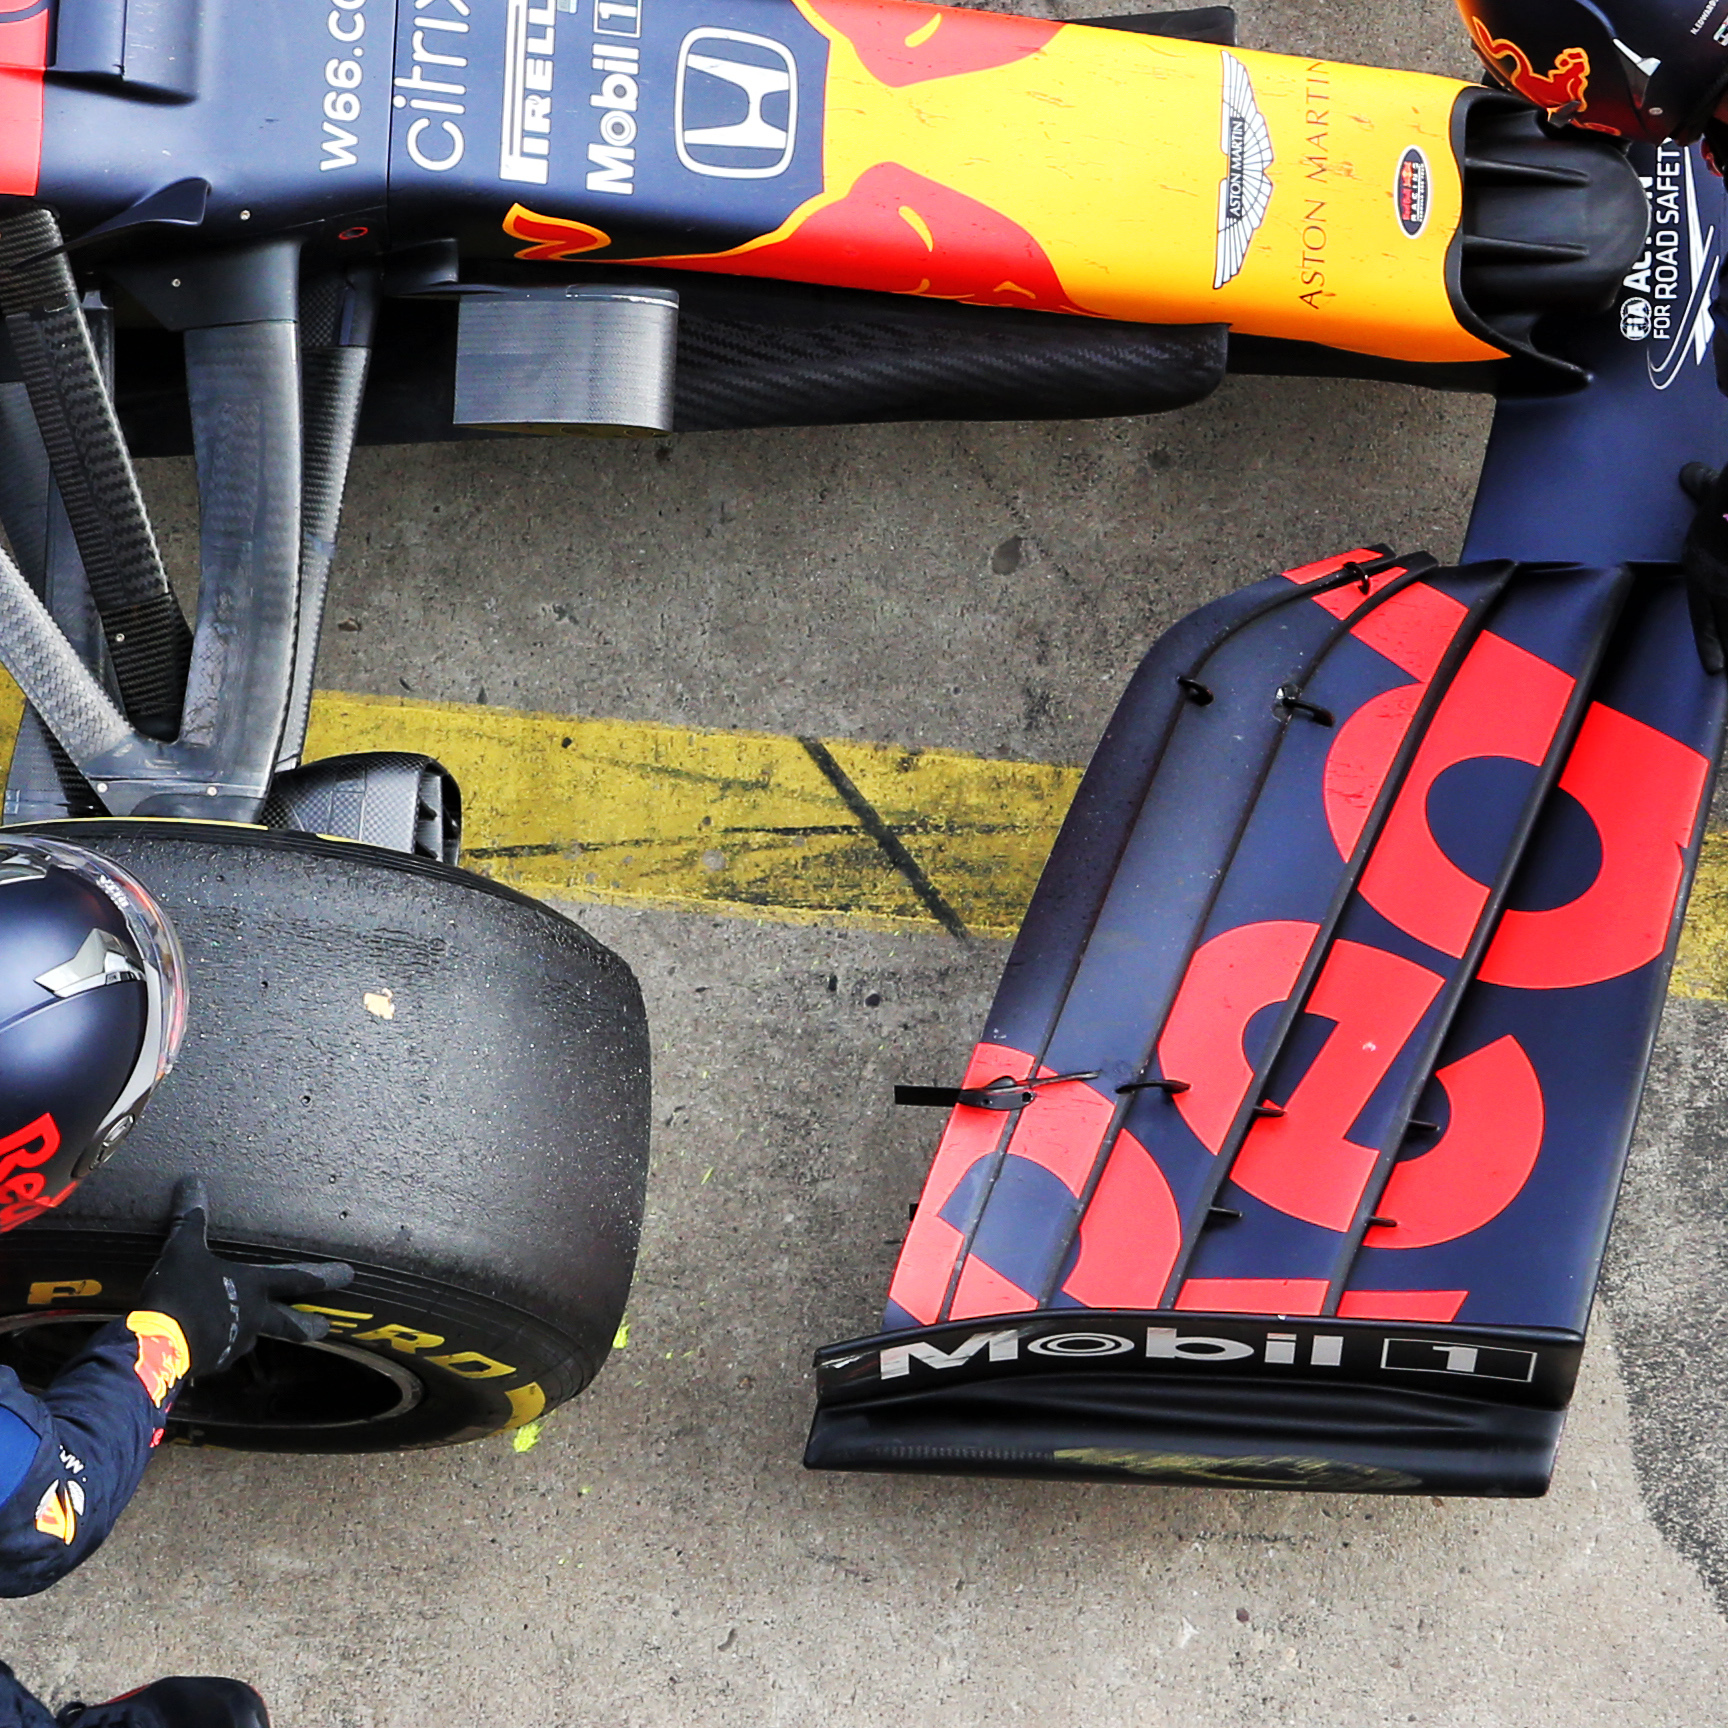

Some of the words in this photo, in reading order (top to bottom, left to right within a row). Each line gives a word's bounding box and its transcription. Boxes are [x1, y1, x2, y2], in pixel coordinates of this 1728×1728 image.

[586, 43, 641, 195] Mobil
[1230, 120, 1244, 171] MARTIN
[1305, 60, 1330, 184] MARTIN
[1229, 178, 1243, 217] ASTON
[1299, 199, 1327, 310] ASTON
[1655, 230, 1679, 299] ROAD
[1654, 304, 1671, 339] FOR
[289, 1302, 518, 1379] ERO
[880, 1327, 1345, 1382] Mobil
